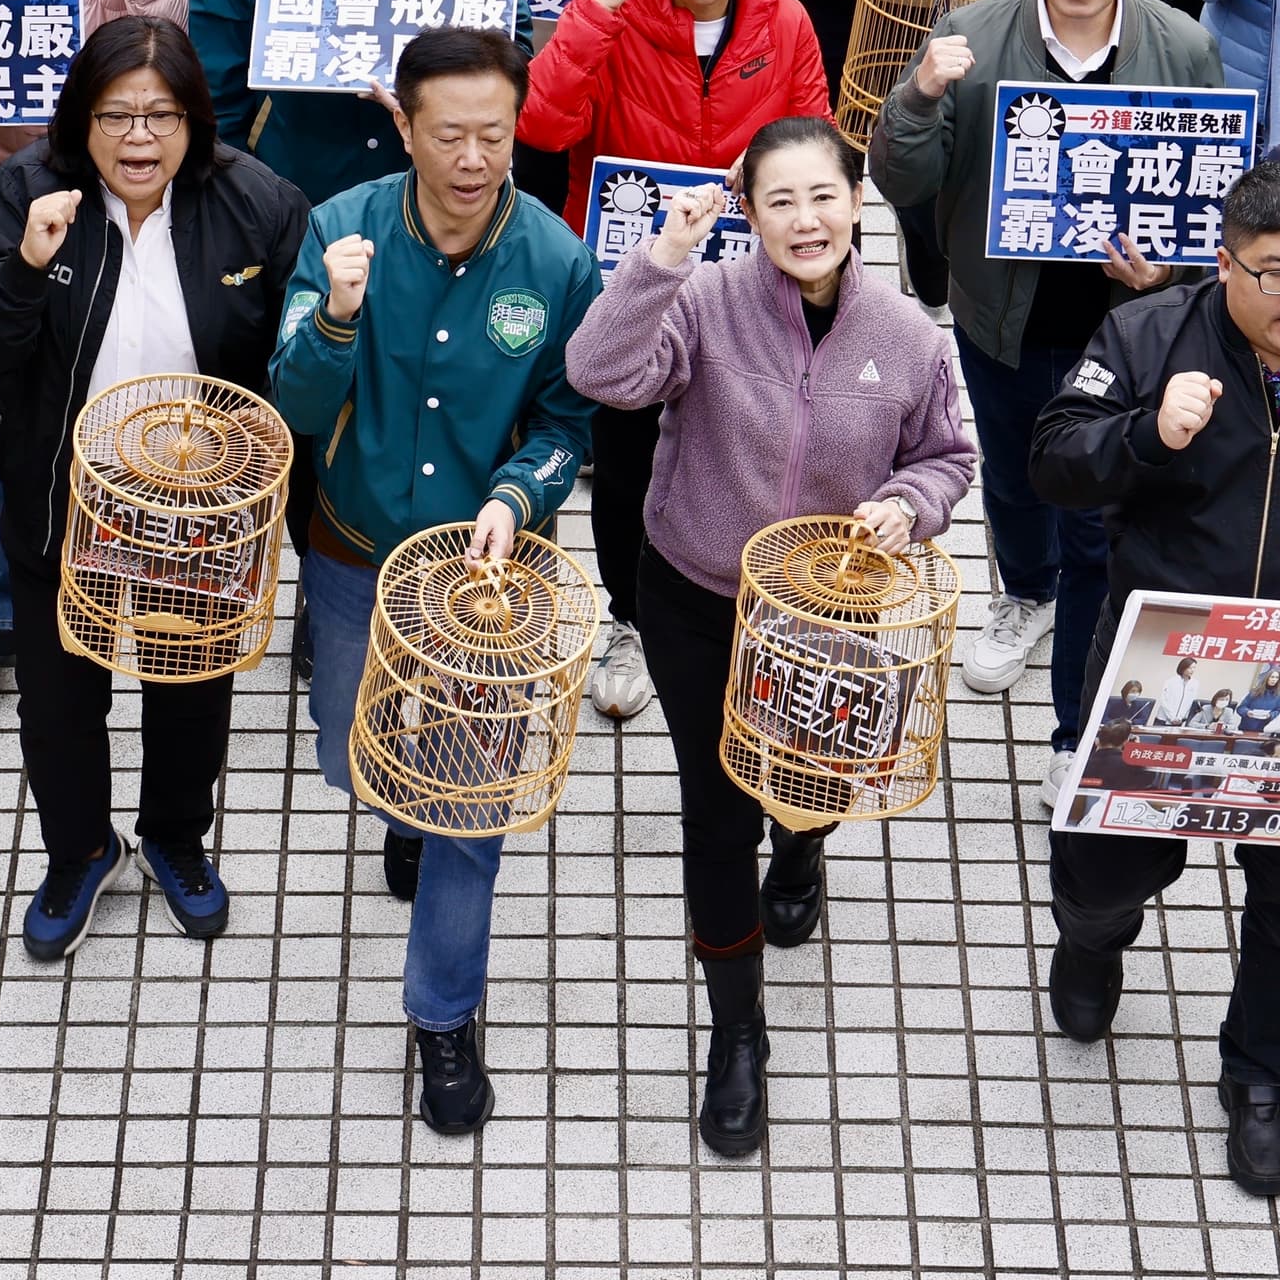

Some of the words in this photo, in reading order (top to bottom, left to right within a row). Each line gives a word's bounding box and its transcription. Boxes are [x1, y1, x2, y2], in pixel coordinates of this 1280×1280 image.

[1068, 109, 1244, 135] 一分鐘沒收罷免權
[1003, 138, 1245, 199] 國會戒嚴
[998, 198, 1223, 258] 霸凌民主
[502, 322, 530, 338] 2024
[1176, 633, 1227, 659] 鎖門
[1113, 801, 1249, 833] 12-16-113
